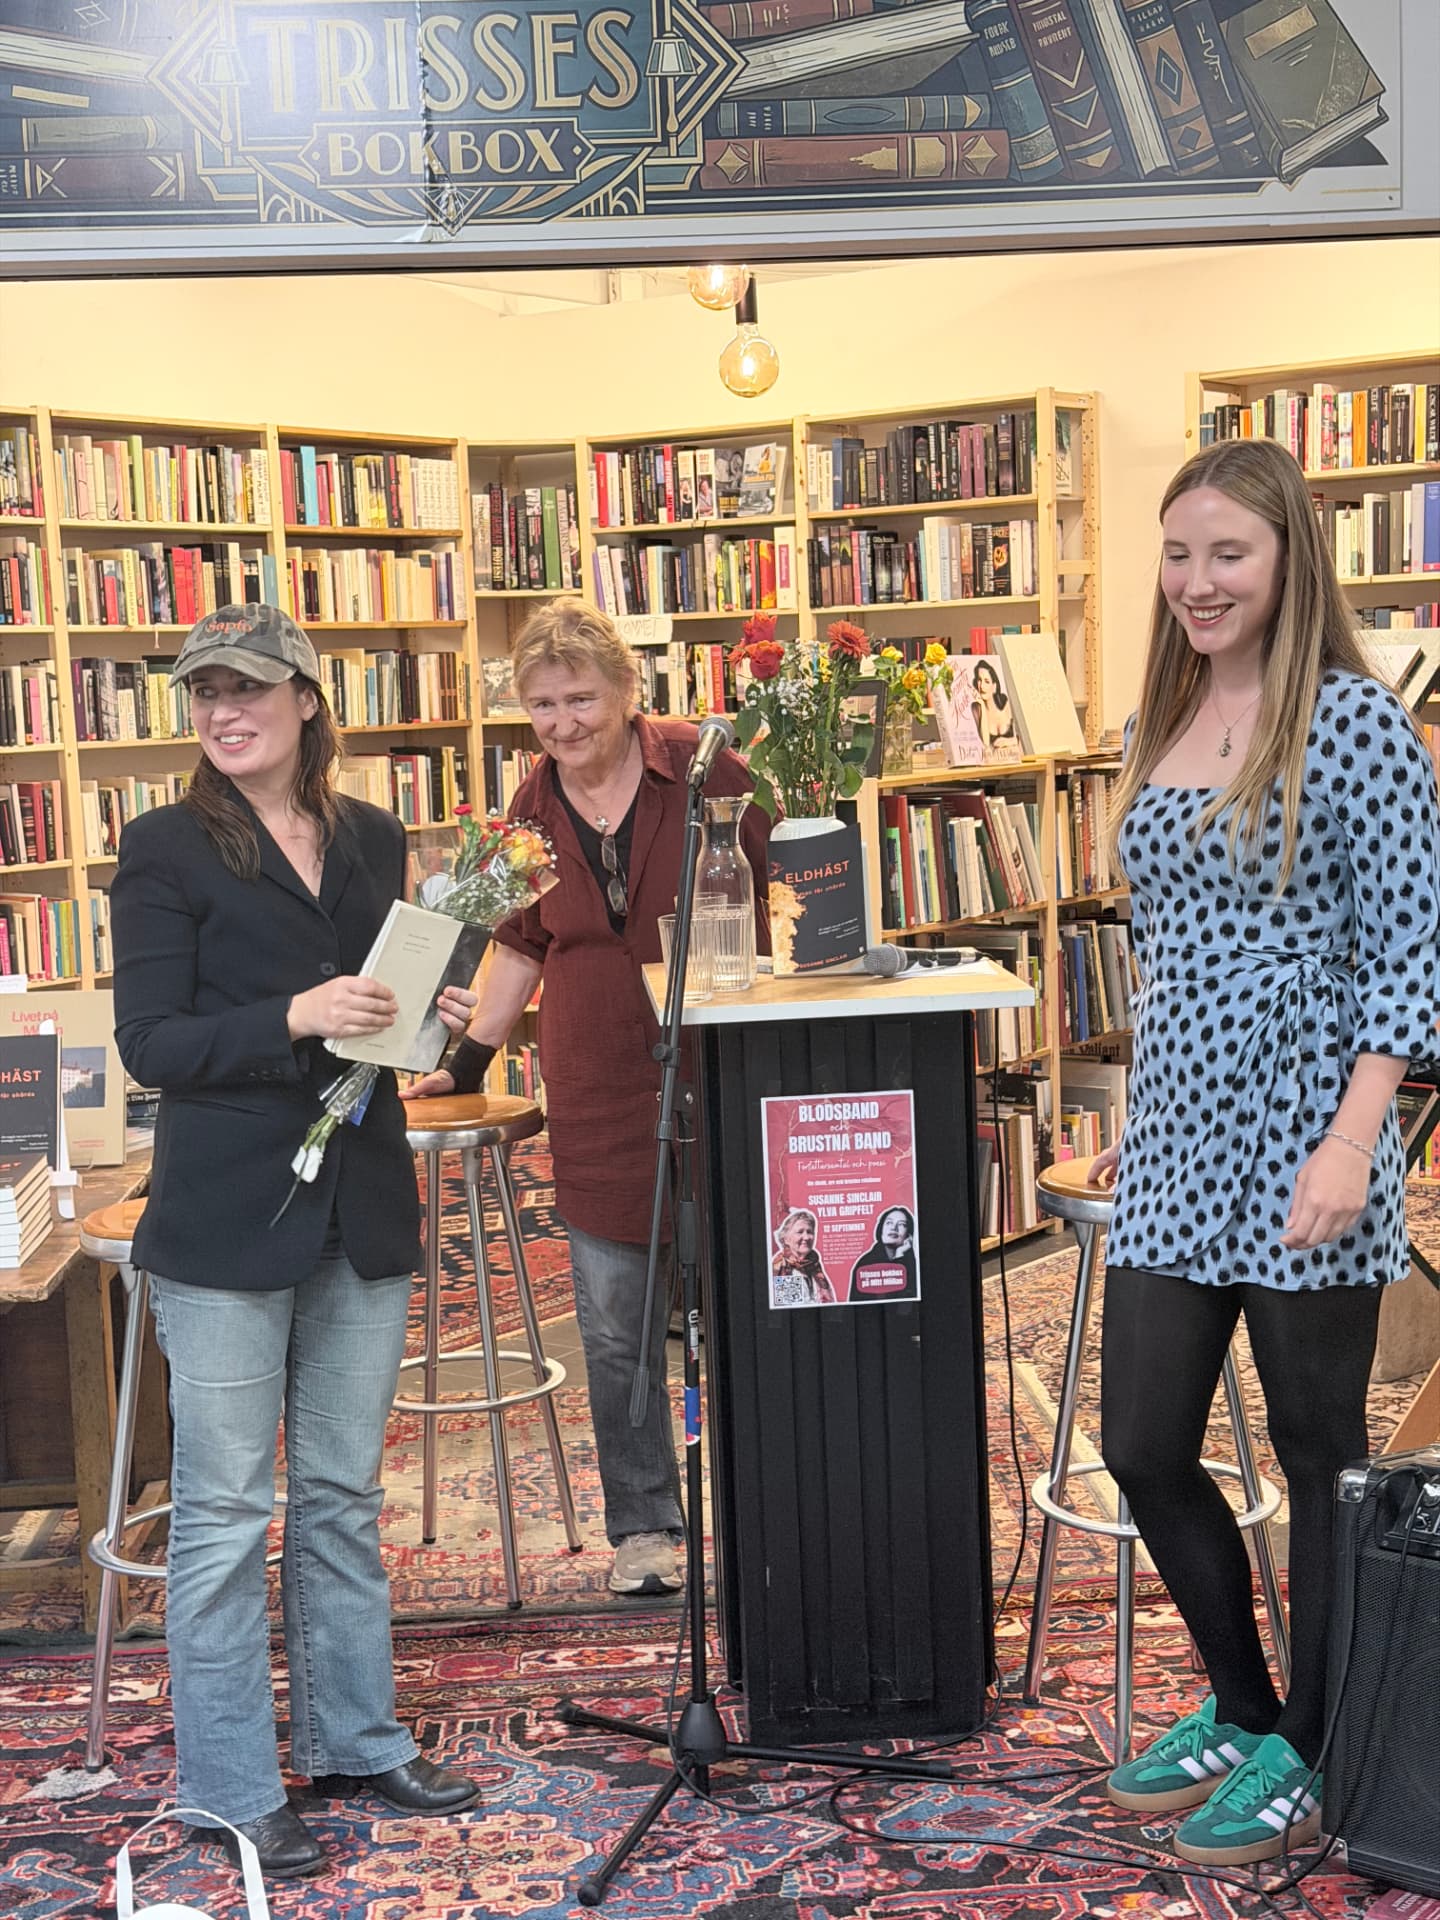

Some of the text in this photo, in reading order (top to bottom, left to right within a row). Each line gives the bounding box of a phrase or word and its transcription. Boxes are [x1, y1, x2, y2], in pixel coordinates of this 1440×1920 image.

[248, 10, 641, 113] TRISSES
[327, 128, 566, 177] BOKBOX
[1074, 781, 1084, 824] WIEN
[785, 860, 850, 884] ELDHÄST
[1079, 1042, 1120, 1057] Valiant
[0, 1067, 42, 1084] HÄST
[799, 1101, 880, 1123] BLODSBAND
[829, 1119, 850, 1132] och
[789, 1131, 892, 1154] BRUSTNA BAND
[808, 1191, 883, 1206] SUSANNE SINCLAIR
[817, 1204, 875, 1218] YLVA GRIPFELT
[831, 1223, 866, 1233] SEPTEMBER
